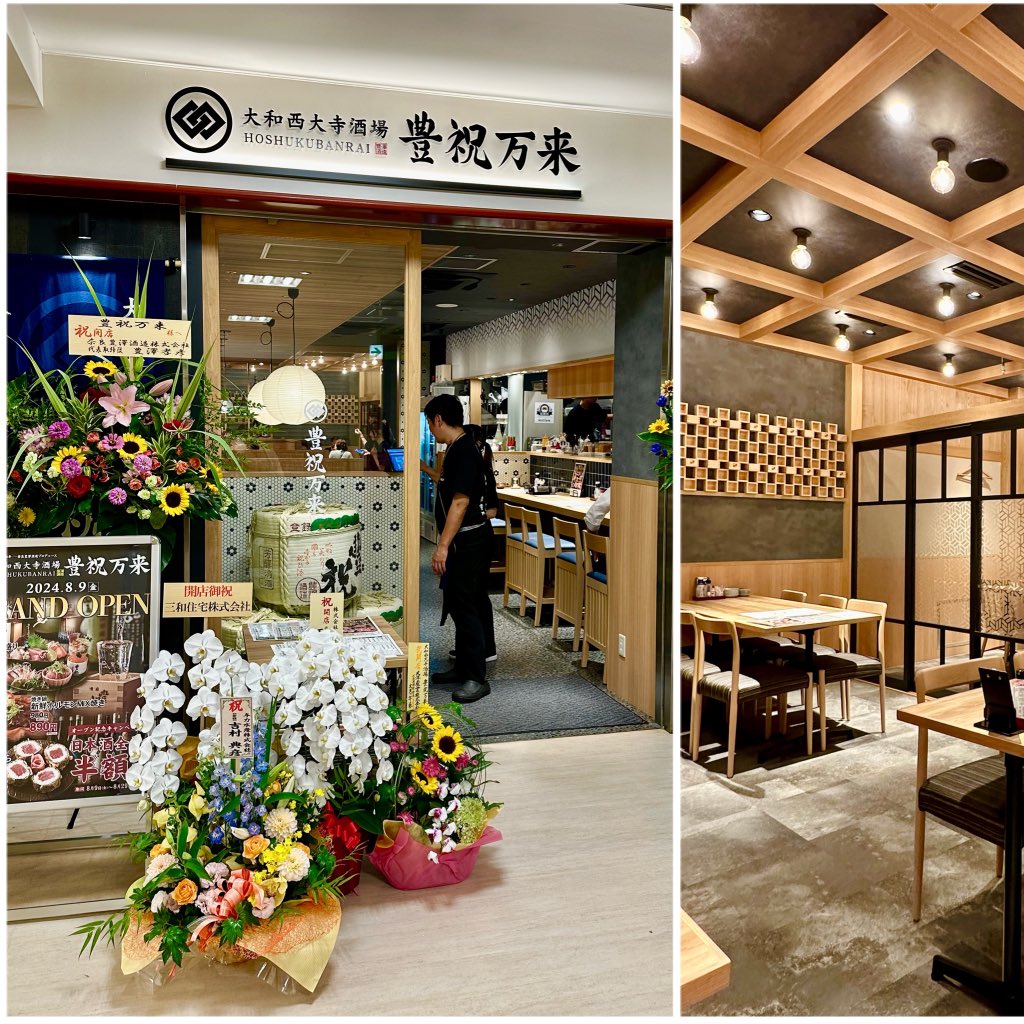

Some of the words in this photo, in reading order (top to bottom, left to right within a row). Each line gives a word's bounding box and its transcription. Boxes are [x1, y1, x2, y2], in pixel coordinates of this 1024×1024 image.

[242, 107, 389, 139] 大和西大寺酒場
[398, 111, 581, 176] 豊祝万来
[243, 132, 371, 154] HOSHUKUBANRAI
[304, 426, 327, 514] 豊祝万来
[64, 554, 151, 577] 豊祝万来
[26, 581, 87, 594] 2024.8.9
[184, 585, 233, 597] 開店御祝
[76, 593, 150, 618] OPEN
[165, 601, 251, 613] 三和住宅株式会社
[229, 699, 243, 712] 祝
[30, 722, 58, 732] 890円
[71, 736, 129, 753] 日本酒全
[71, 754, 129, 784] 半額
